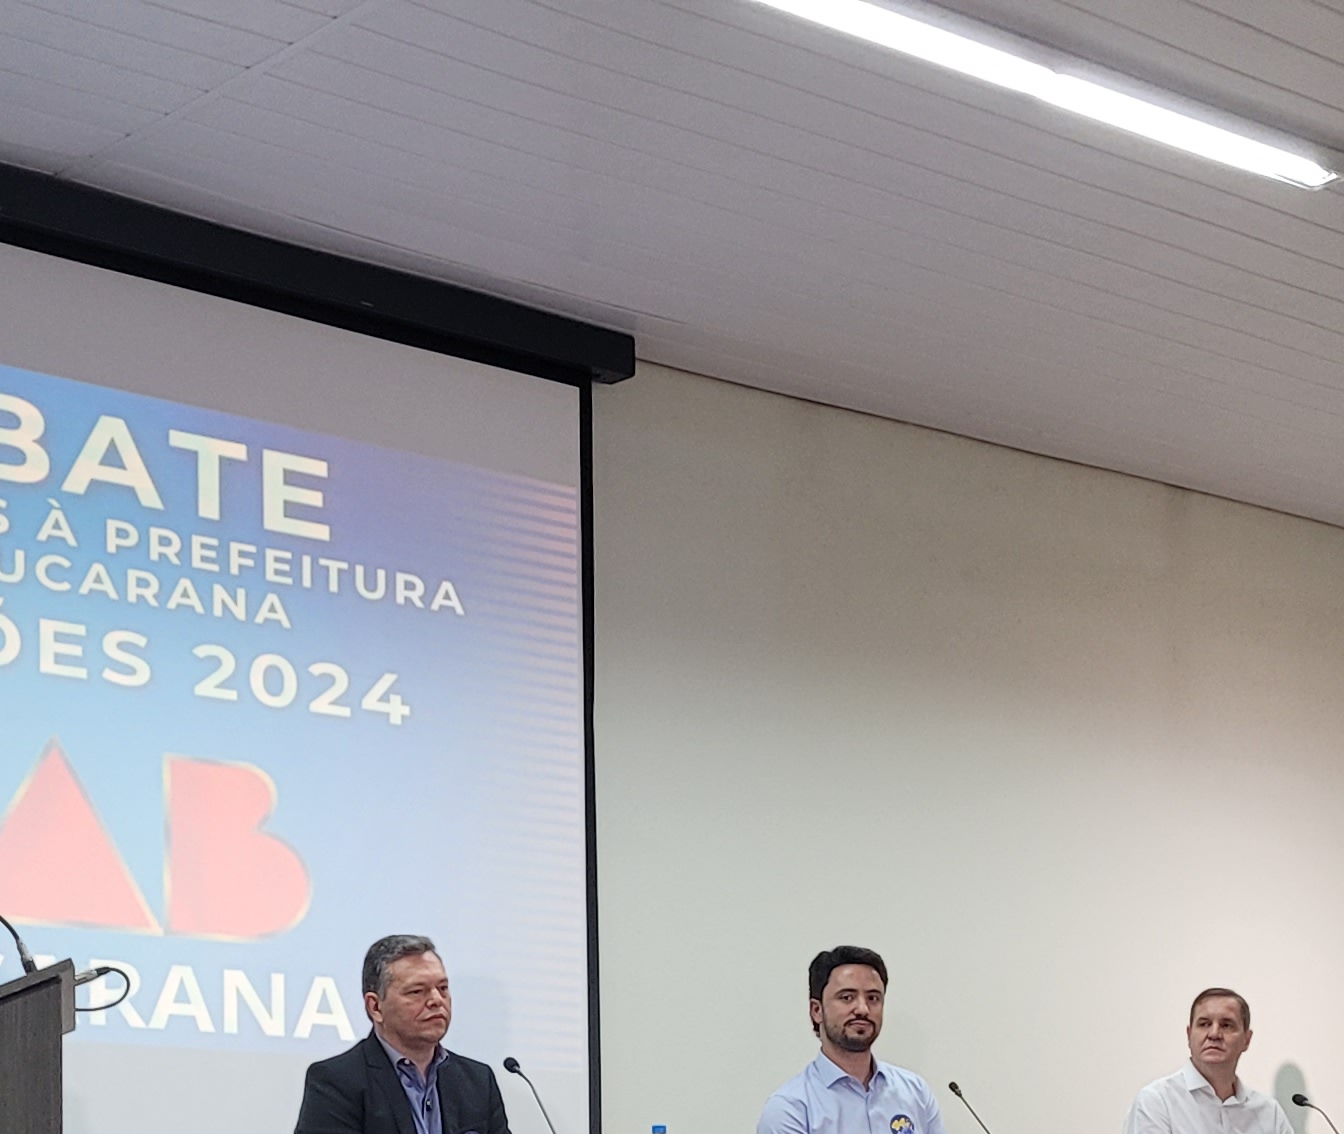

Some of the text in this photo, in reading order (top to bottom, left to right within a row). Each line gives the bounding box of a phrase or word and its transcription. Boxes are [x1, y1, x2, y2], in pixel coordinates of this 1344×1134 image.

[36, 499, 78, 547] À
[106, 518, 465, 615] PREFEITURA
[192, 644, 411, 725] 2024
